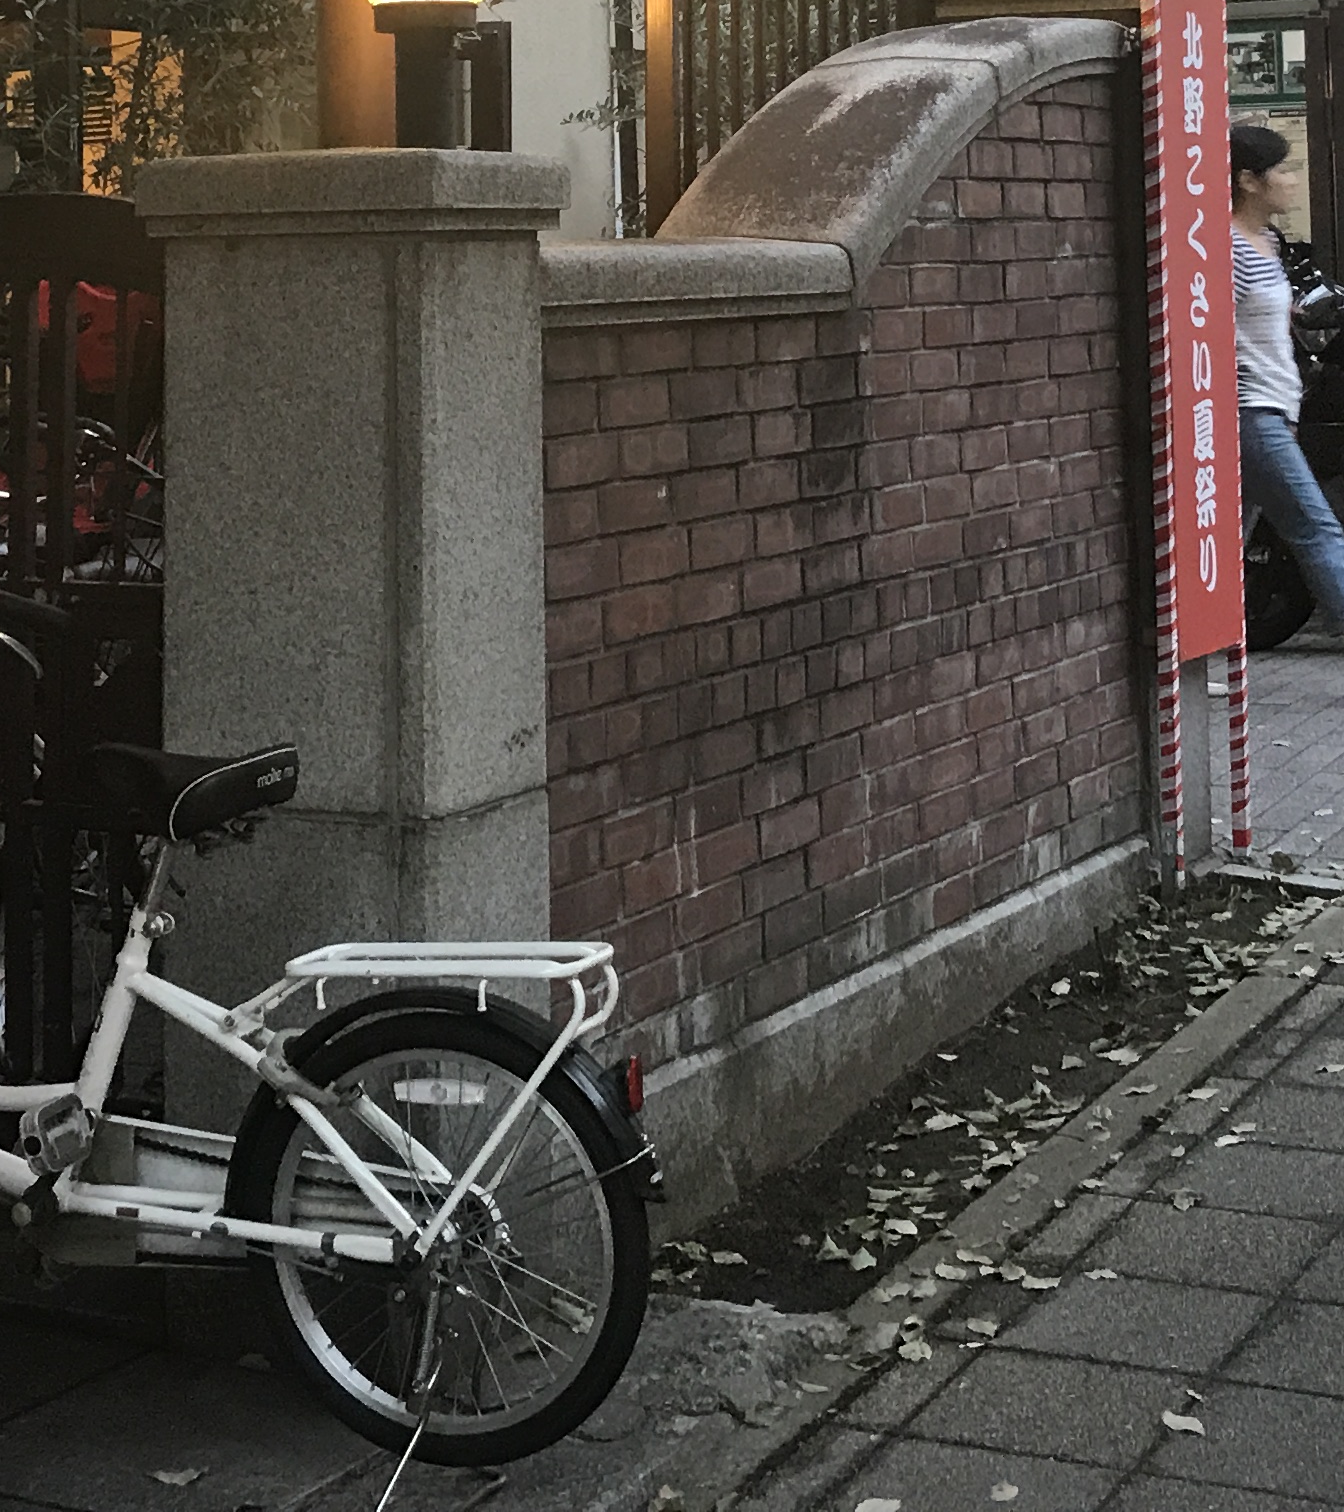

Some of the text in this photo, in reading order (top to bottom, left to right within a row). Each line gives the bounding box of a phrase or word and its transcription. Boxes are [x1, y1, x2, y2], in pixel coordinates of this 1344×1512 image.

[1180, 9, 1219, 593] 北野こくさい夏祭り
